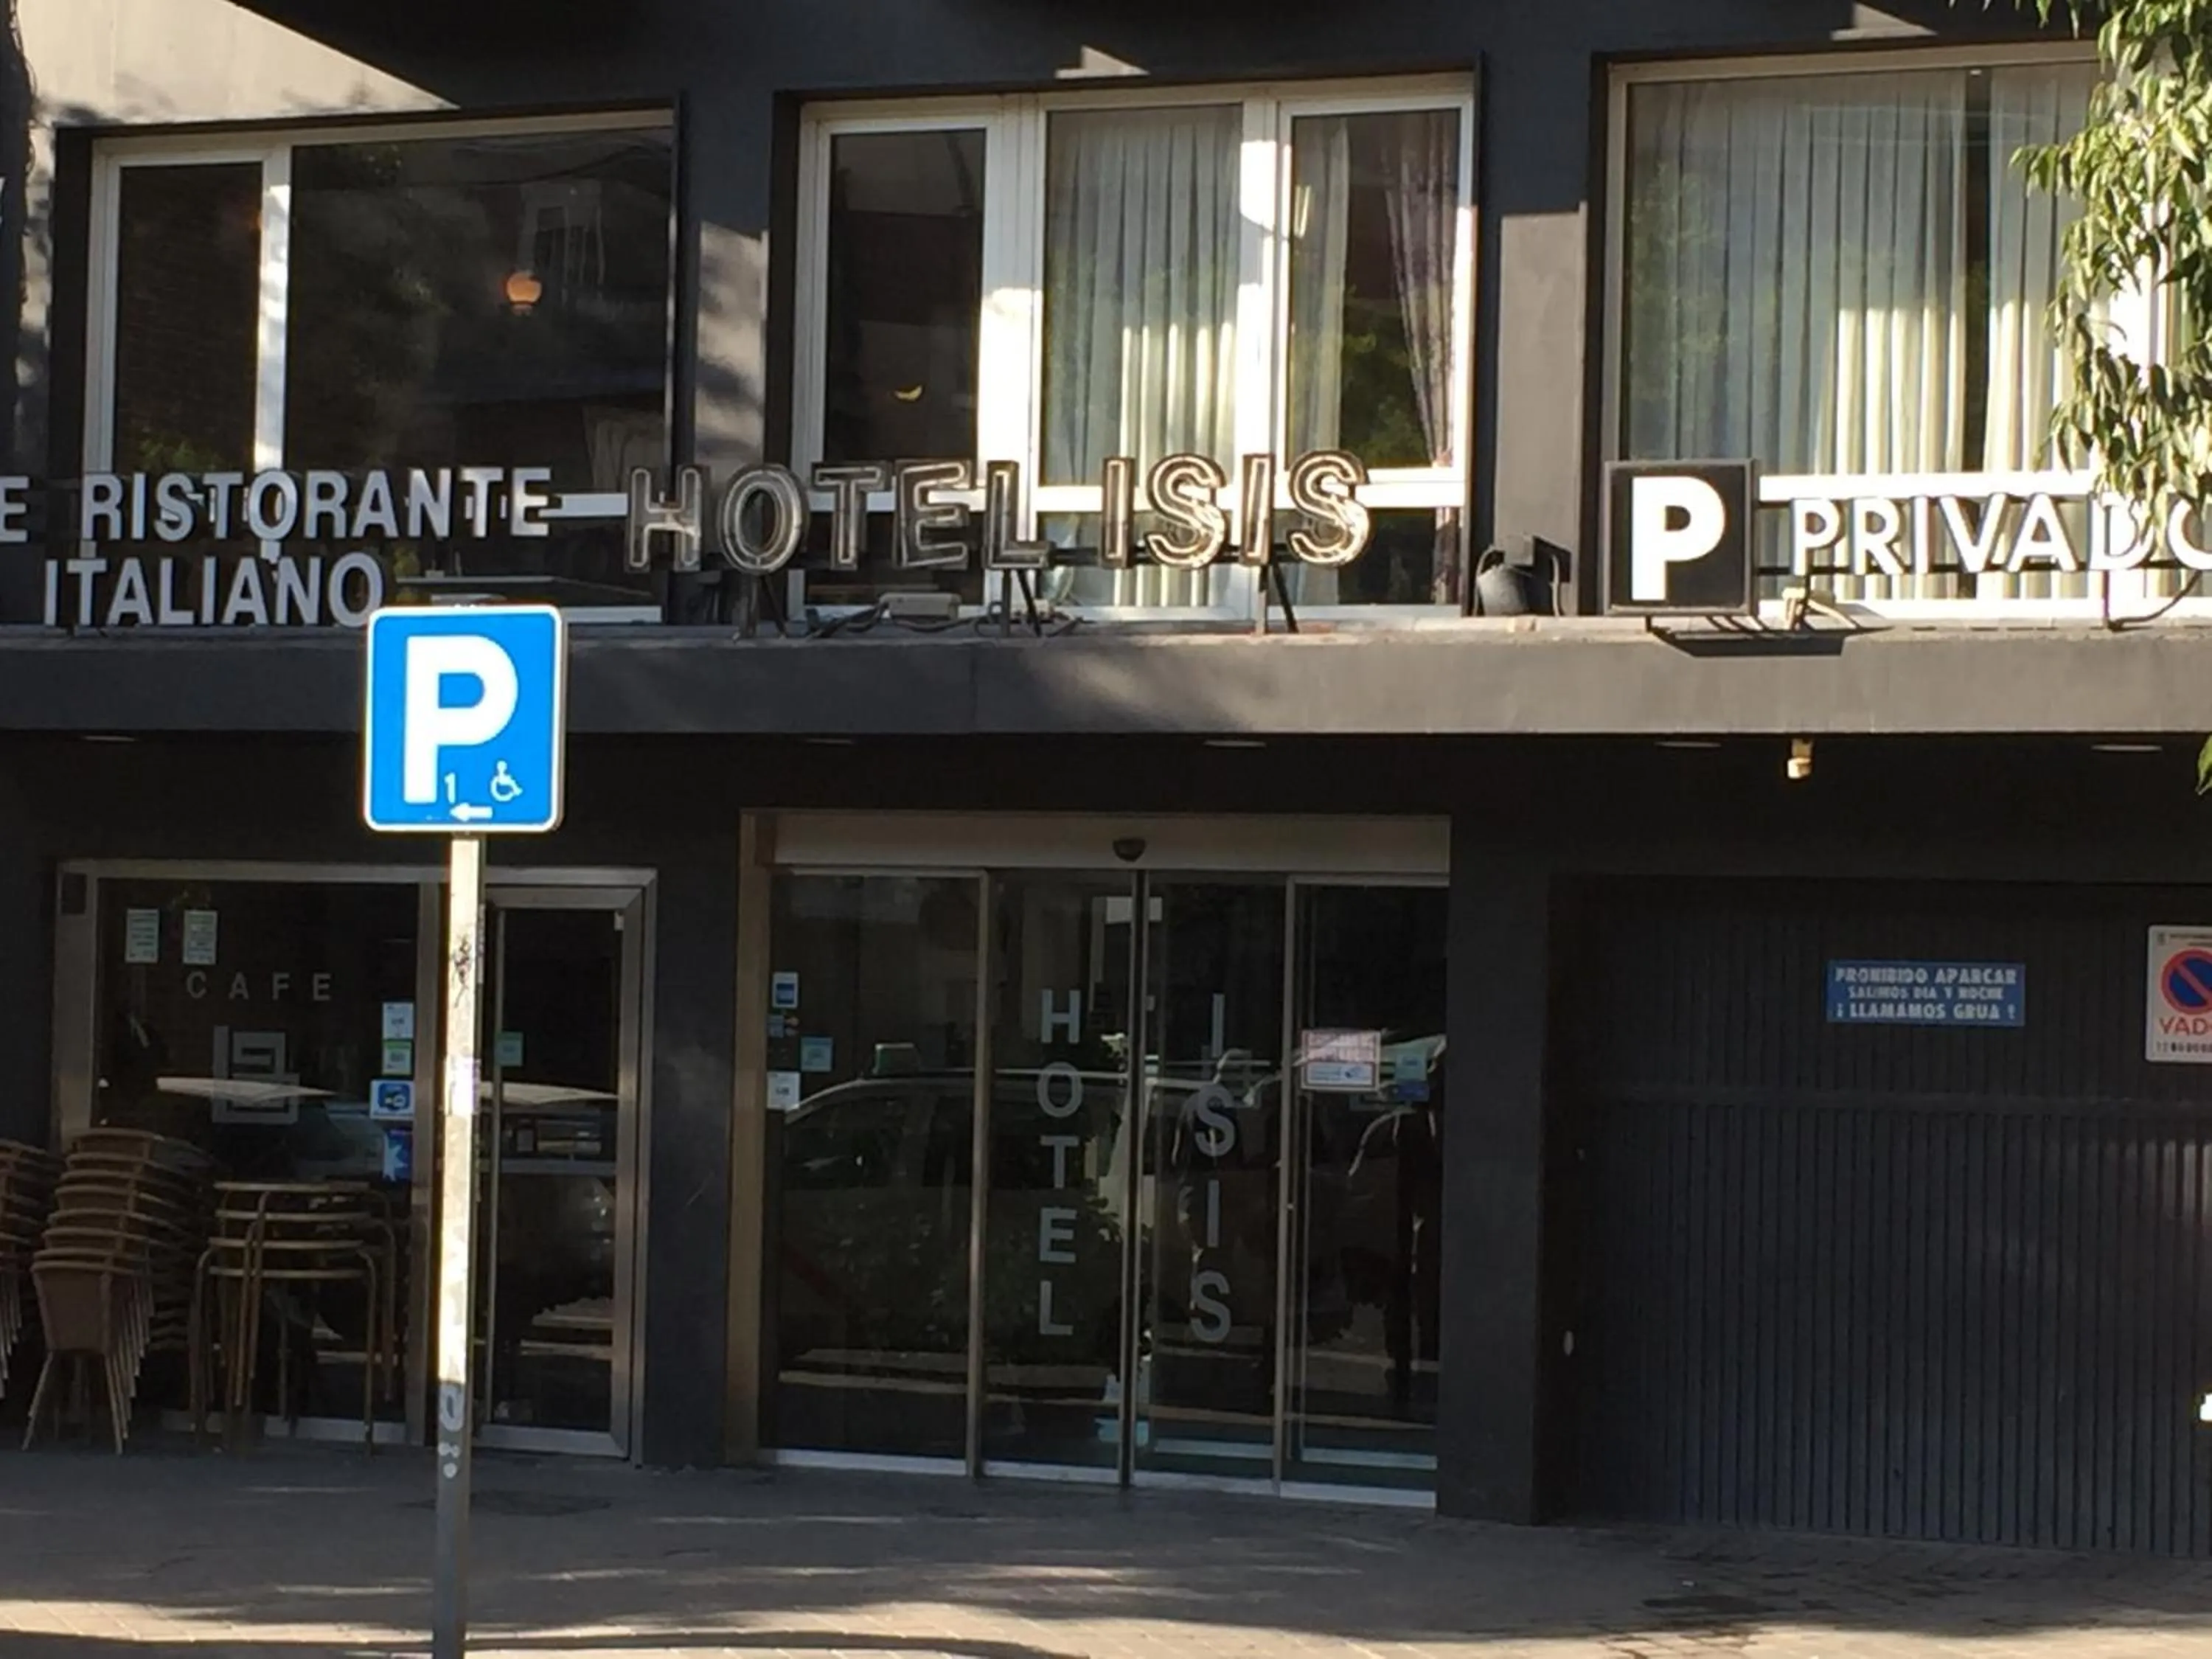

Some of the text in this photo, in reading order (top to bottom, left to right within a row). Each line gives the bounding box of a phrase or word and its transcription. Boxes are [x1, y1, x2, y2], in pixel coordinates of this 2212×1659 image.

[81, 467, 551, 543] RISTORANTE
[624, 451, 1373, 574] HOTEL ISIS
[1631, 476, 1727, 601] P
[44, 552, 385, 628] ITALIANO
[403, 635, 518, 804] P
[444, 772, 456, 804] 1
[186, 970, 331, 1001] CAFE
[1835, 967, 2017, 984] PROHIBIDO APARCAR
[1848, 986, 1908, 999] SALIMOS
[1944, 987, 1952, 999] Y
[1958, 987, 2004, 1000] NOCHE
[1850, 1002, 1946, 1019] LLAMAMOS
[1954, 1004, 2000, 1020] GRUA
[1037, 988, 1084, 1336] HOTEL
[1189, 993, 1236, 1342] ISIS
